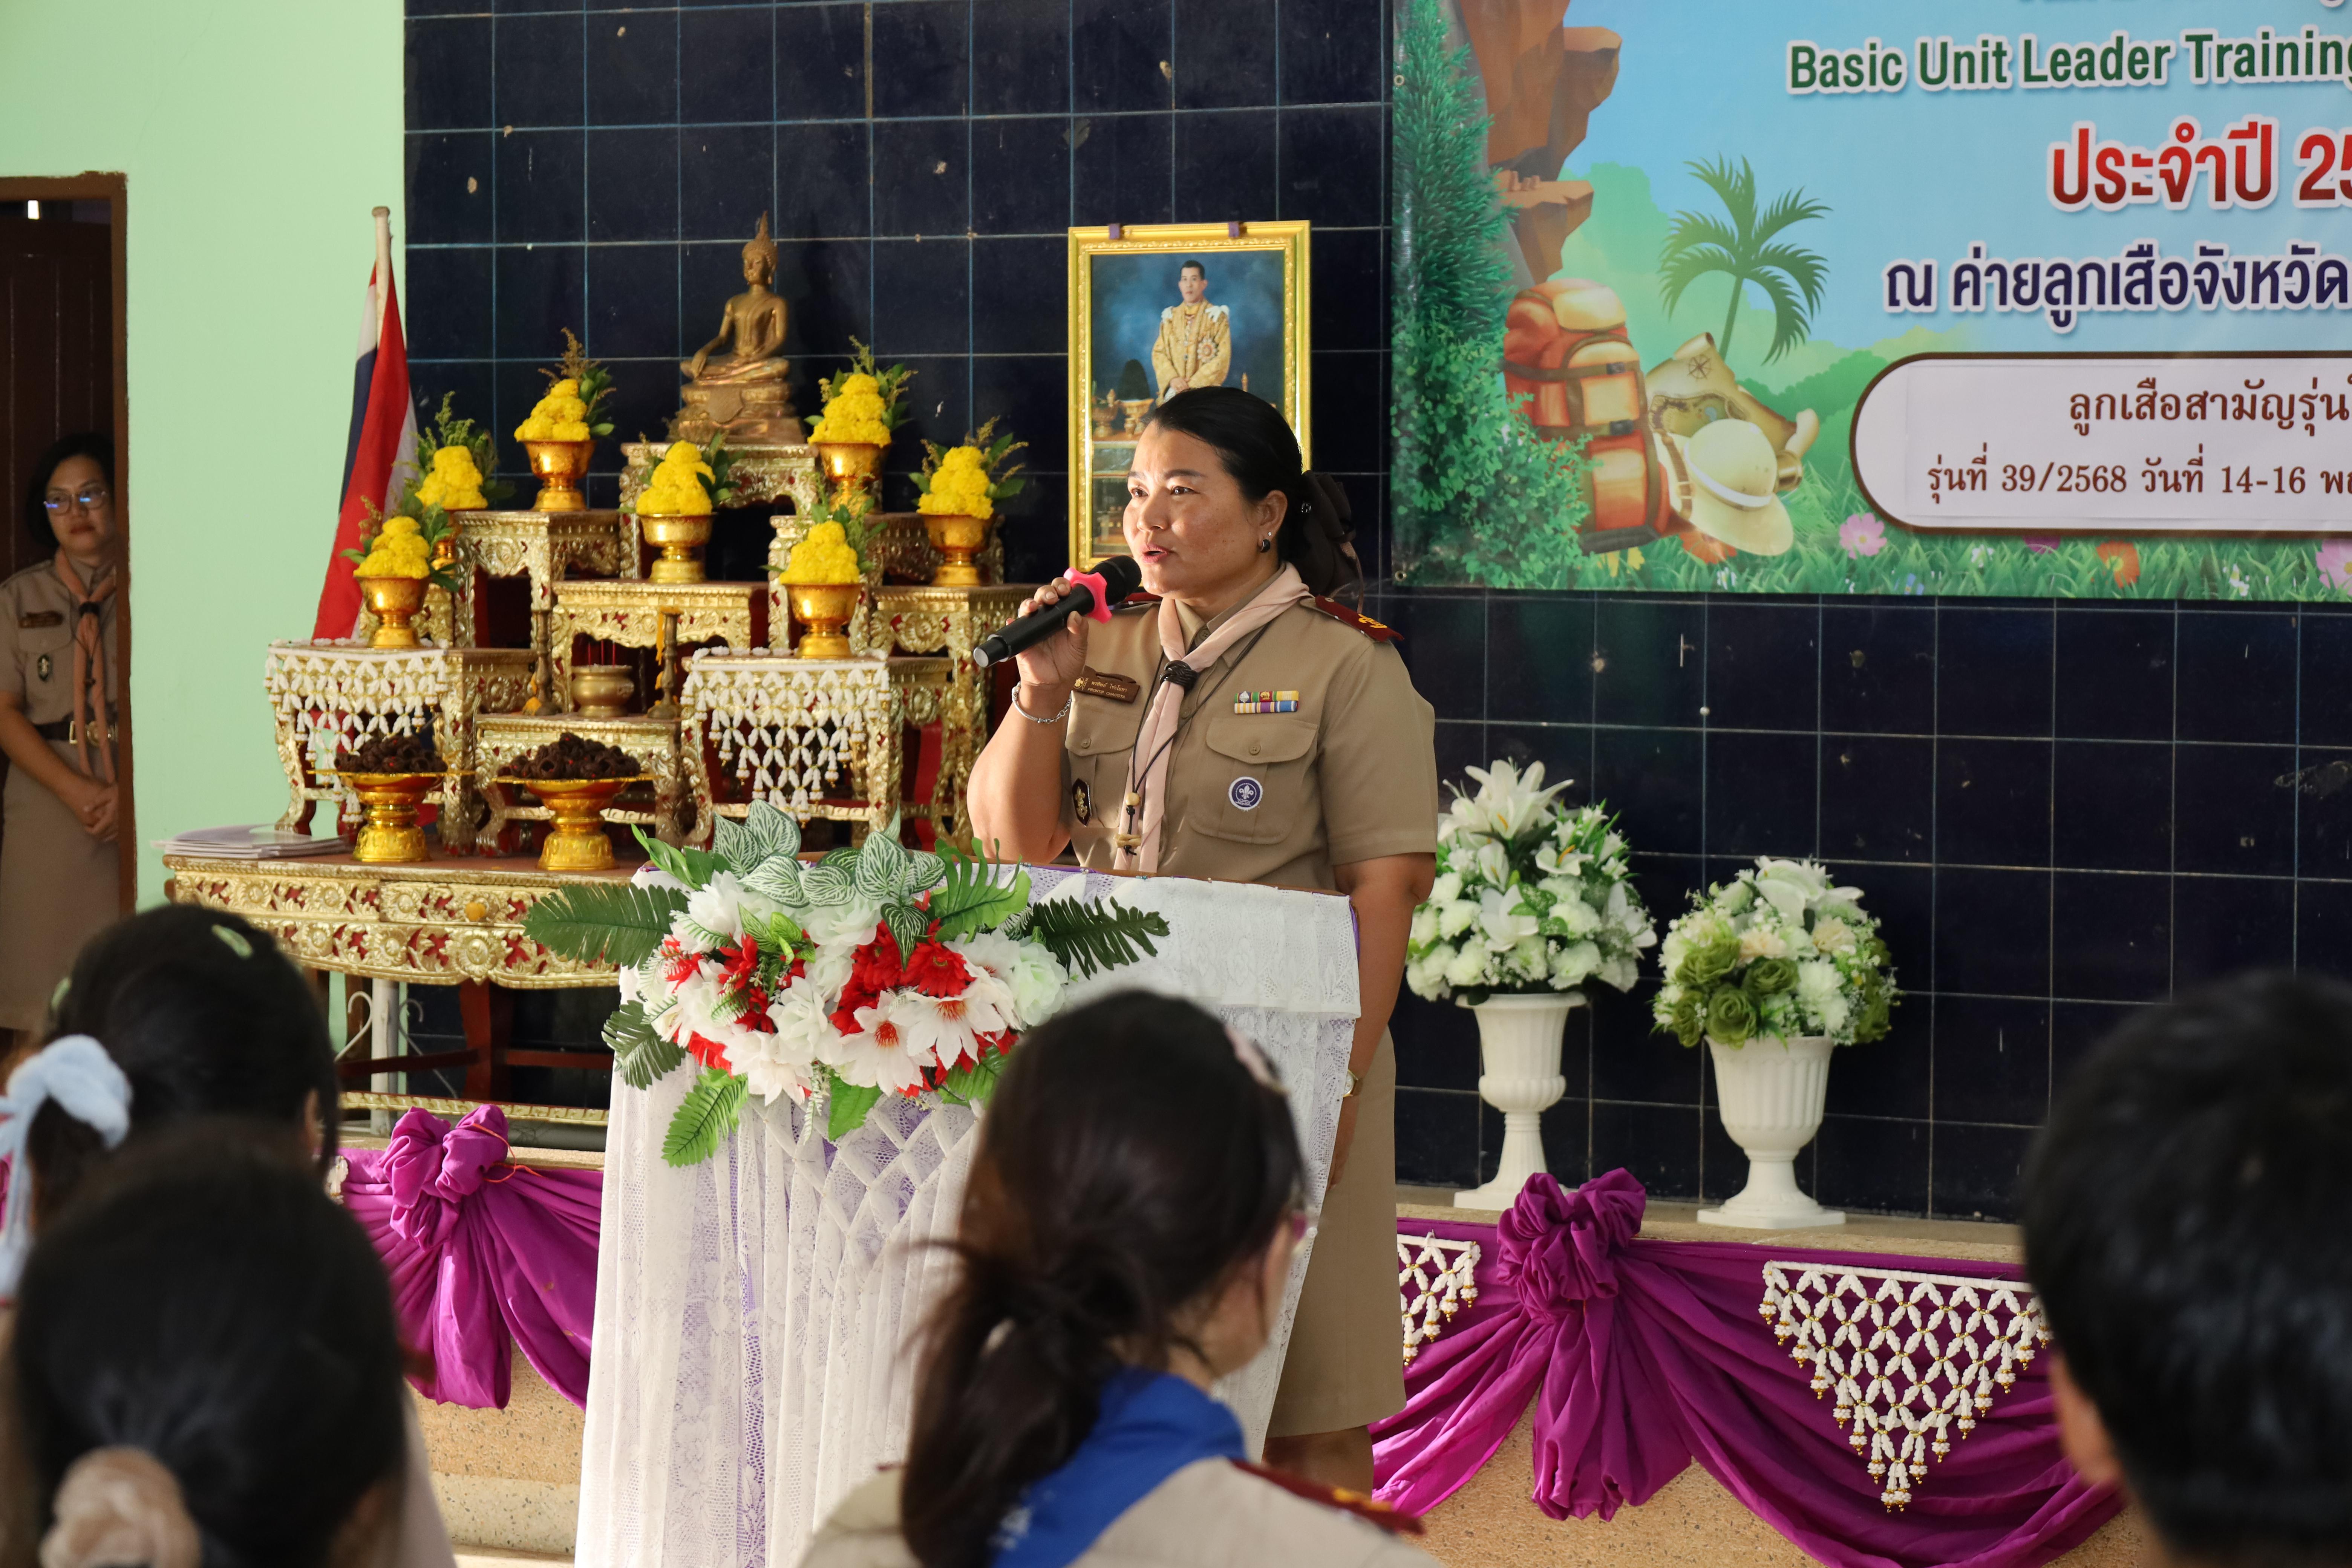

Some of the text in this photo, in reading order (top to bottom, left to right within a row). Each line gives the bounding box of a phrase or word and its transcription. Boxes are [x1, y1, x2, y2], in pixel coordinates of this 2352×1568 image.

[1792, 30, 2352, 88] Basic Unit Leader Trainin
[2053, 121, 2272, 204] ประจำปี
[1886, 244, 2348, 328] ณ ค่ายลูกเสือจังหวัด
[2070, 373, 2352, 437] ลูกเสือสามัญรุ่น
[1928, 442, 2352, 504] รุ่นที่ 39/2568 วันที่ 14-16 พ
